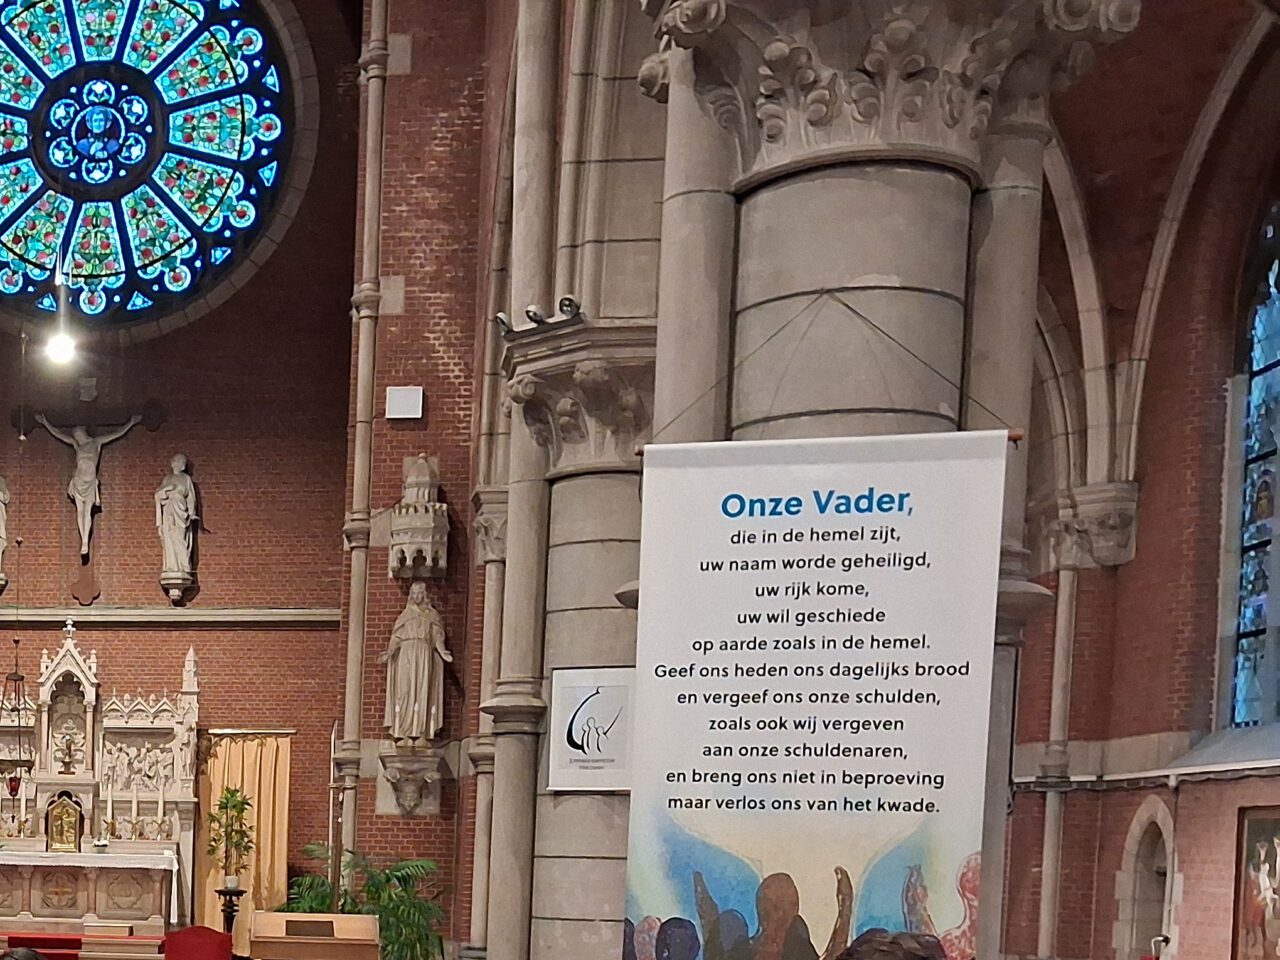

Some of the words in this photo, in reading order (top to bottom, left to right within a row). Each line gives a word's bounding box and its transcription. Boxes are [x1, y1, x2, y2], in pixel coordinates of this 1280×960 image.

[720, 493, 803, 519] Onze
[812, 486, 913, 517] Vader,
[730, 529, 757, 545] die
[761, 529, 777, 544] in
[782, 527, 805, 543] de
[809, 525, 865, 543] hemel
[869, 525, 901, 545] zijt,
[699, 560, 725, 572] uw
[729, 559, 777, 572] naam
[781, 553, 837, 570] worde
[841, 551, 931, 573] geheiligd,
[755, 585, 780, 598] uw
[784, 581, 811, 601] rijk
[816, 580, 870, 598] kome,
[737, 612, 763, 625] uw
[766, 608, 790, 624] wil
[794, 606, 886, 627] geschiede
[691, 640, 714, 656] op
[718, 635, 768, 652] aarde
[772, 634, 816, 651] zoals
[821, 634, 837, 650] in
[842, 634, 865, 650] de
[870, 633, 931, 650] hemel.
[654, 662, 697, 678] Geef
[699, 666, 729, 678] ons
[734, 662, 789, 678] heden
[793, 665, 825, 677] ons
[829, 661, 910, 681] dagelijks
[914, 660, 970, 677] brood
[677, 693, 698, 705] en
[702, 688, 770, 708] vergeef
[772, 692, 803, 704] ons
[808, 692, 850, 704] onze
[855, 688, 941, 707] schulden,
[708, 715, 752, 731] zoals
[756, 715, 788, 731] ook
[792, 715, 817, 735] wij
[821, 719, 904, 735] vergeven
[702, 745, 733, 757] aan
[738, 745, 779, 758] onze
[783, 742, 908, 761] schuldenaren,
[665, 771, 687, 783] en
[691, 768, 742, 787] breng
[746, 772, 777, 784] ons
[782, 769, 816, 785] niet
[820, 769, 836, 785] in
[841, 769, 945, 790] beproeving
[667, 797, 712, 810] maar
[715, 794, 766, 810] verlos
[770, 799, 802, 811] ons
[806, 799, 838, 812] van
[843, 796, 872, 812] het
[877, 796, 940, 814] kwade.
